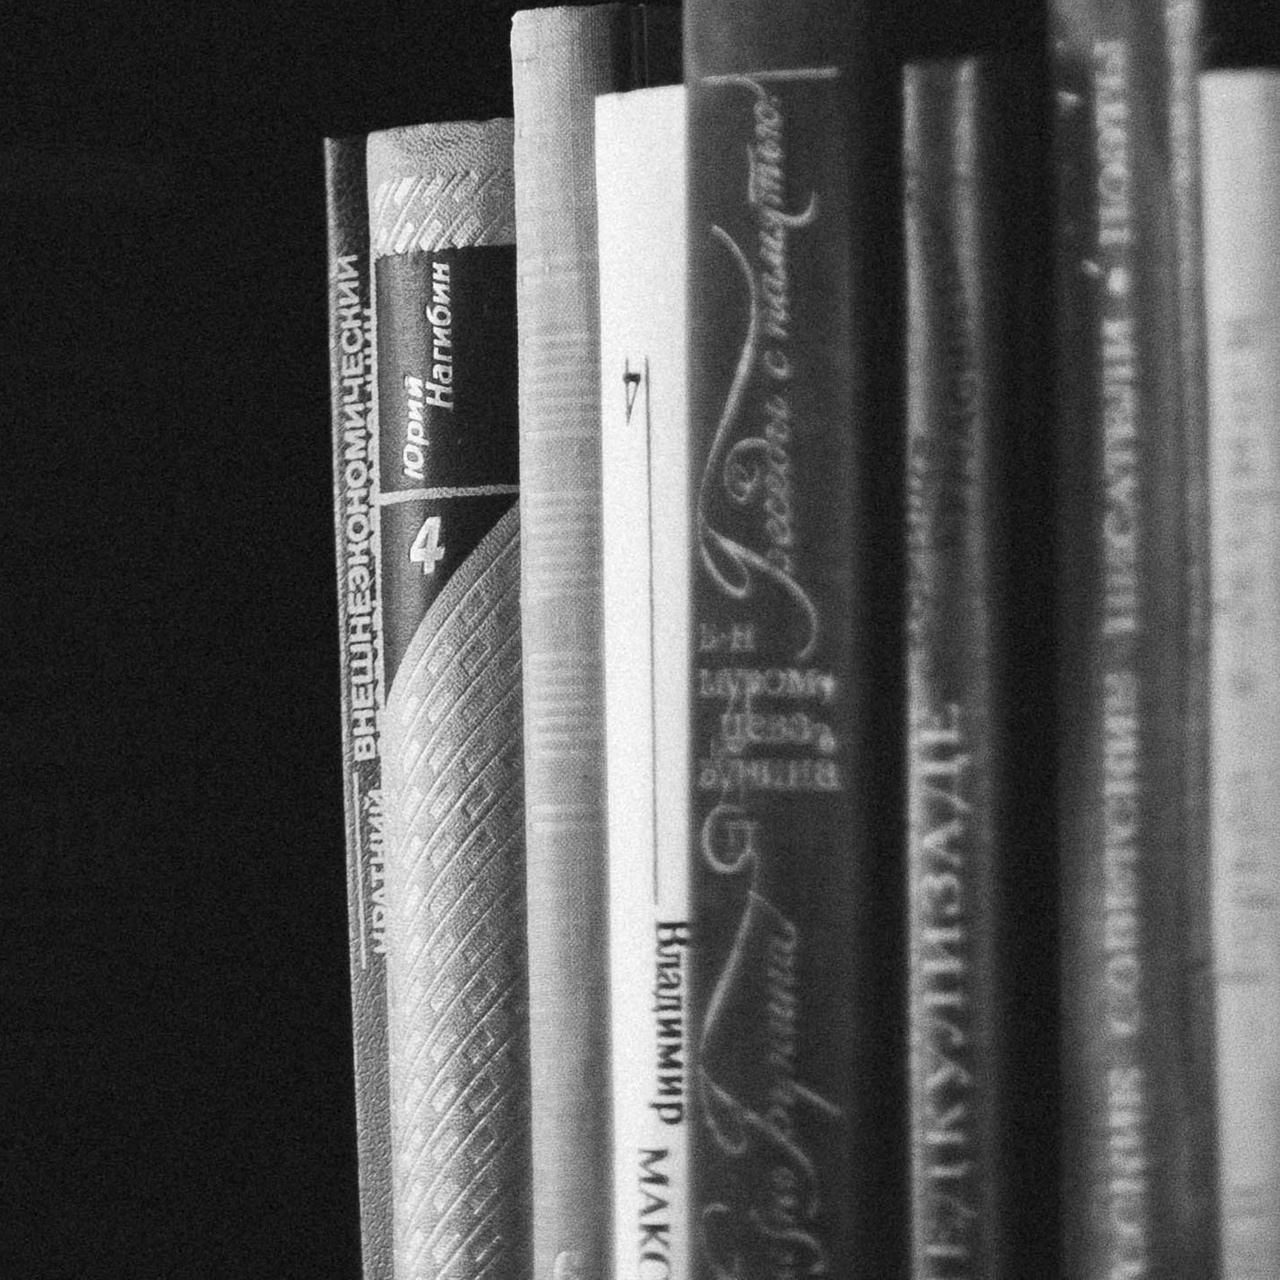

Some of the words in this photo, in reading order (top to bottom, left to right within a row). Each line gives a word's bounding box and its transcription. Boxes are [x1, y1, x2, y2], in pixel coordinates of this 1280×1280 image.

[424, 262, 455, 410] Нагибин
[403, 375, 427, 480] Юрий
[407, 515, 446, 576] 4
[651, 920, 692, 1126] Владимир
